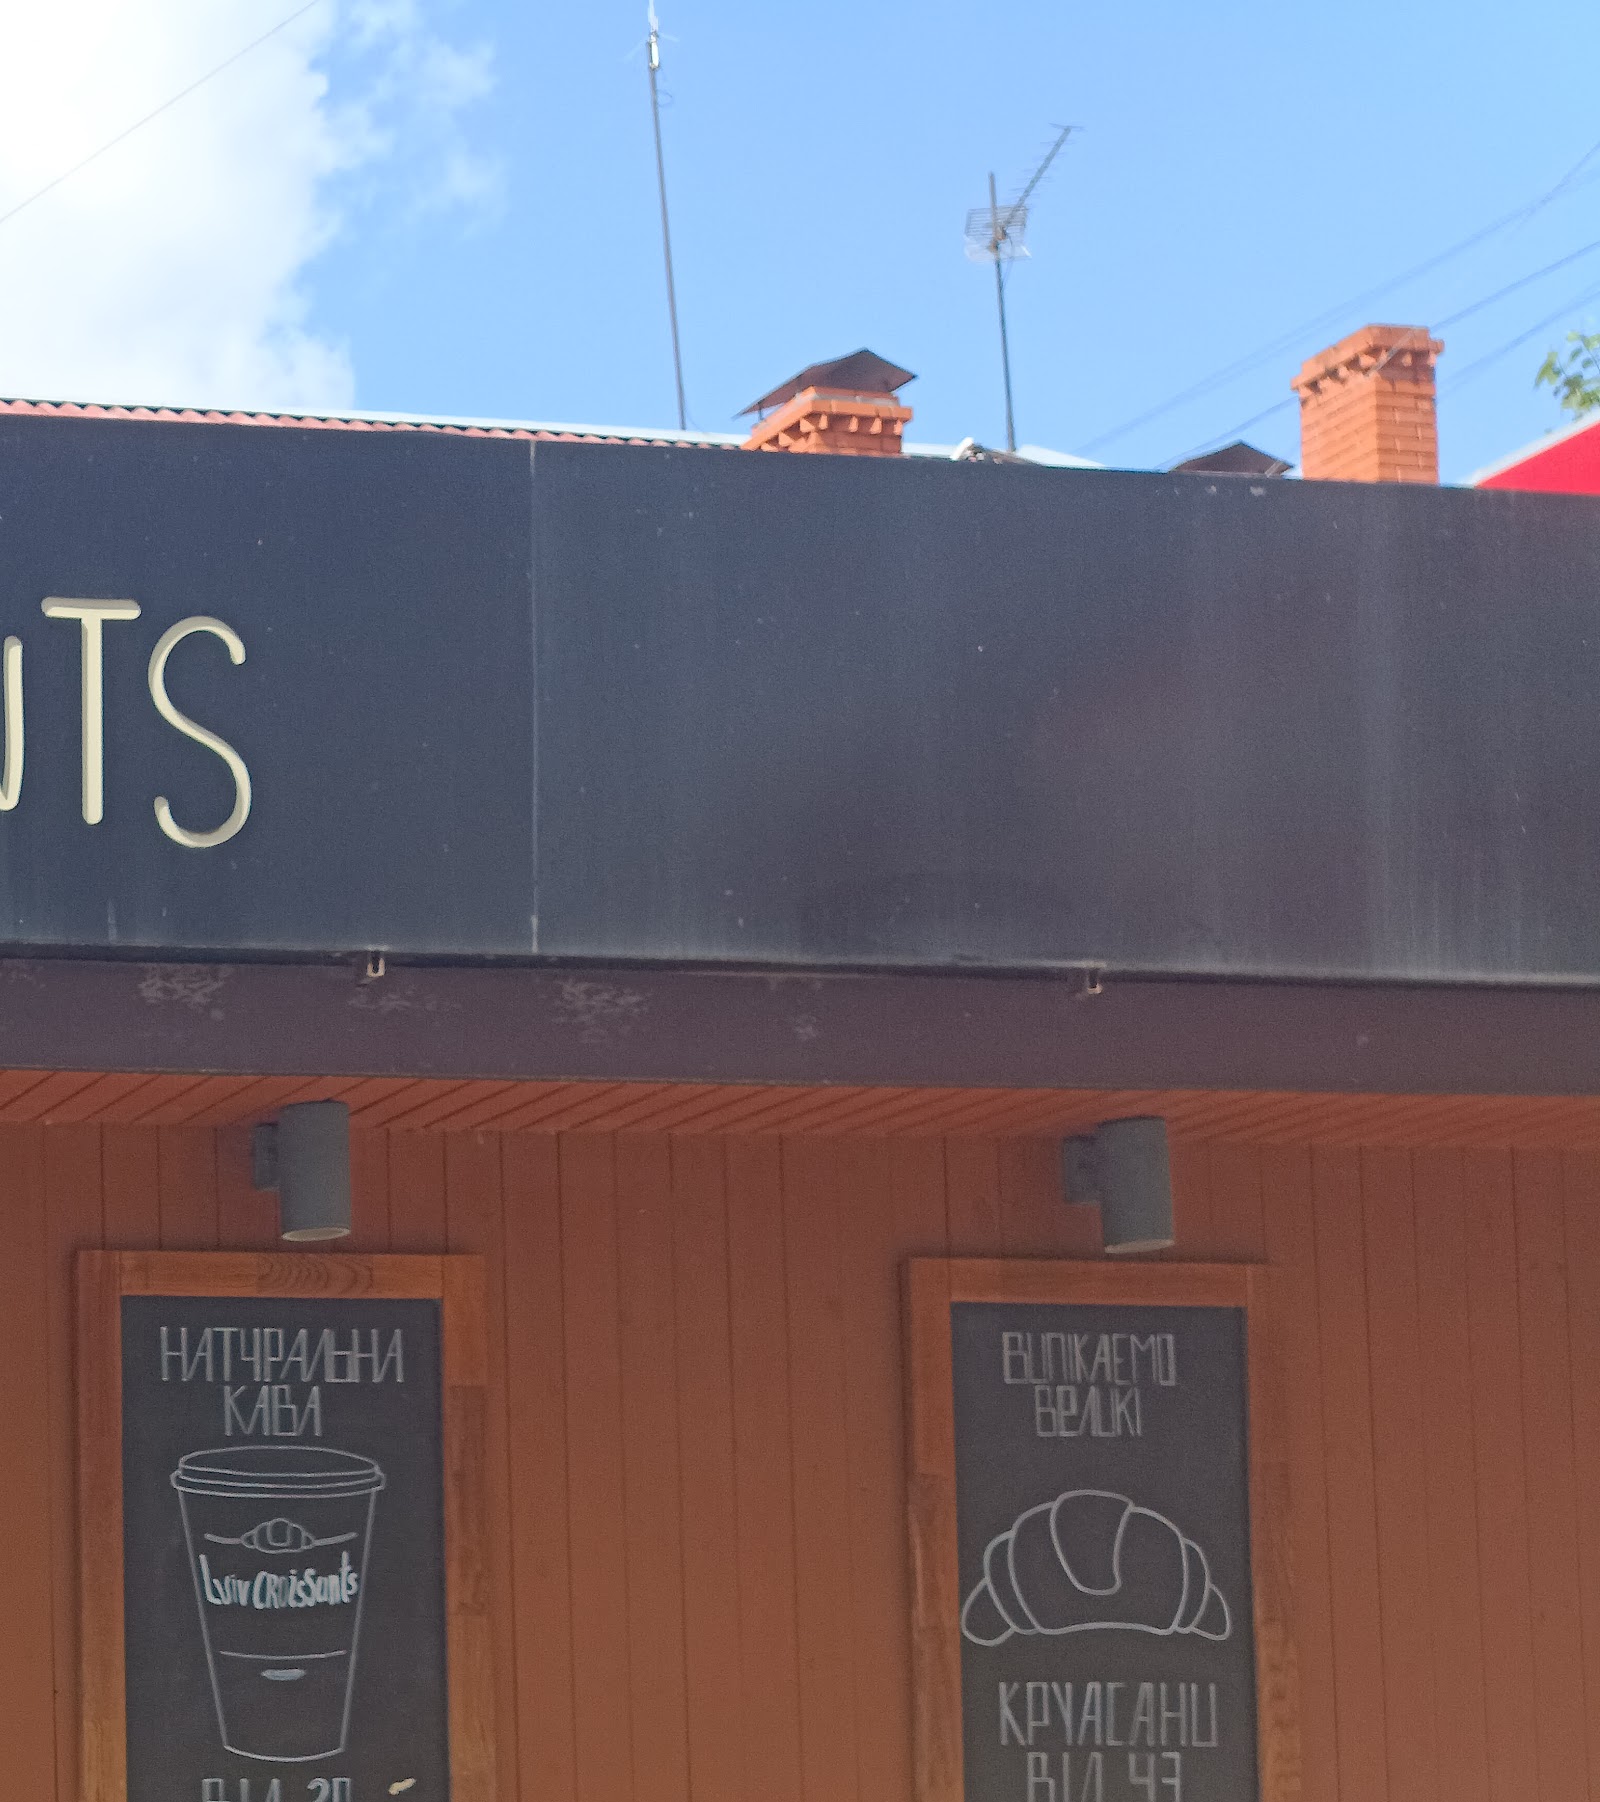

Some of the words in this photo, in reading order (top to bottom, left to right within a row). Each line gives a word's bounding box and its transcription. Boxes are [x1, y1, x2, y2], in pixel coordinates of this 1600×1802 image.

[160, 1326, 404, 1383] НАТУРАЛЬНА
[224, 1385, 322, 1436] КАВА
[999, 1682, 1217, 1747] КРУАСАНИ
